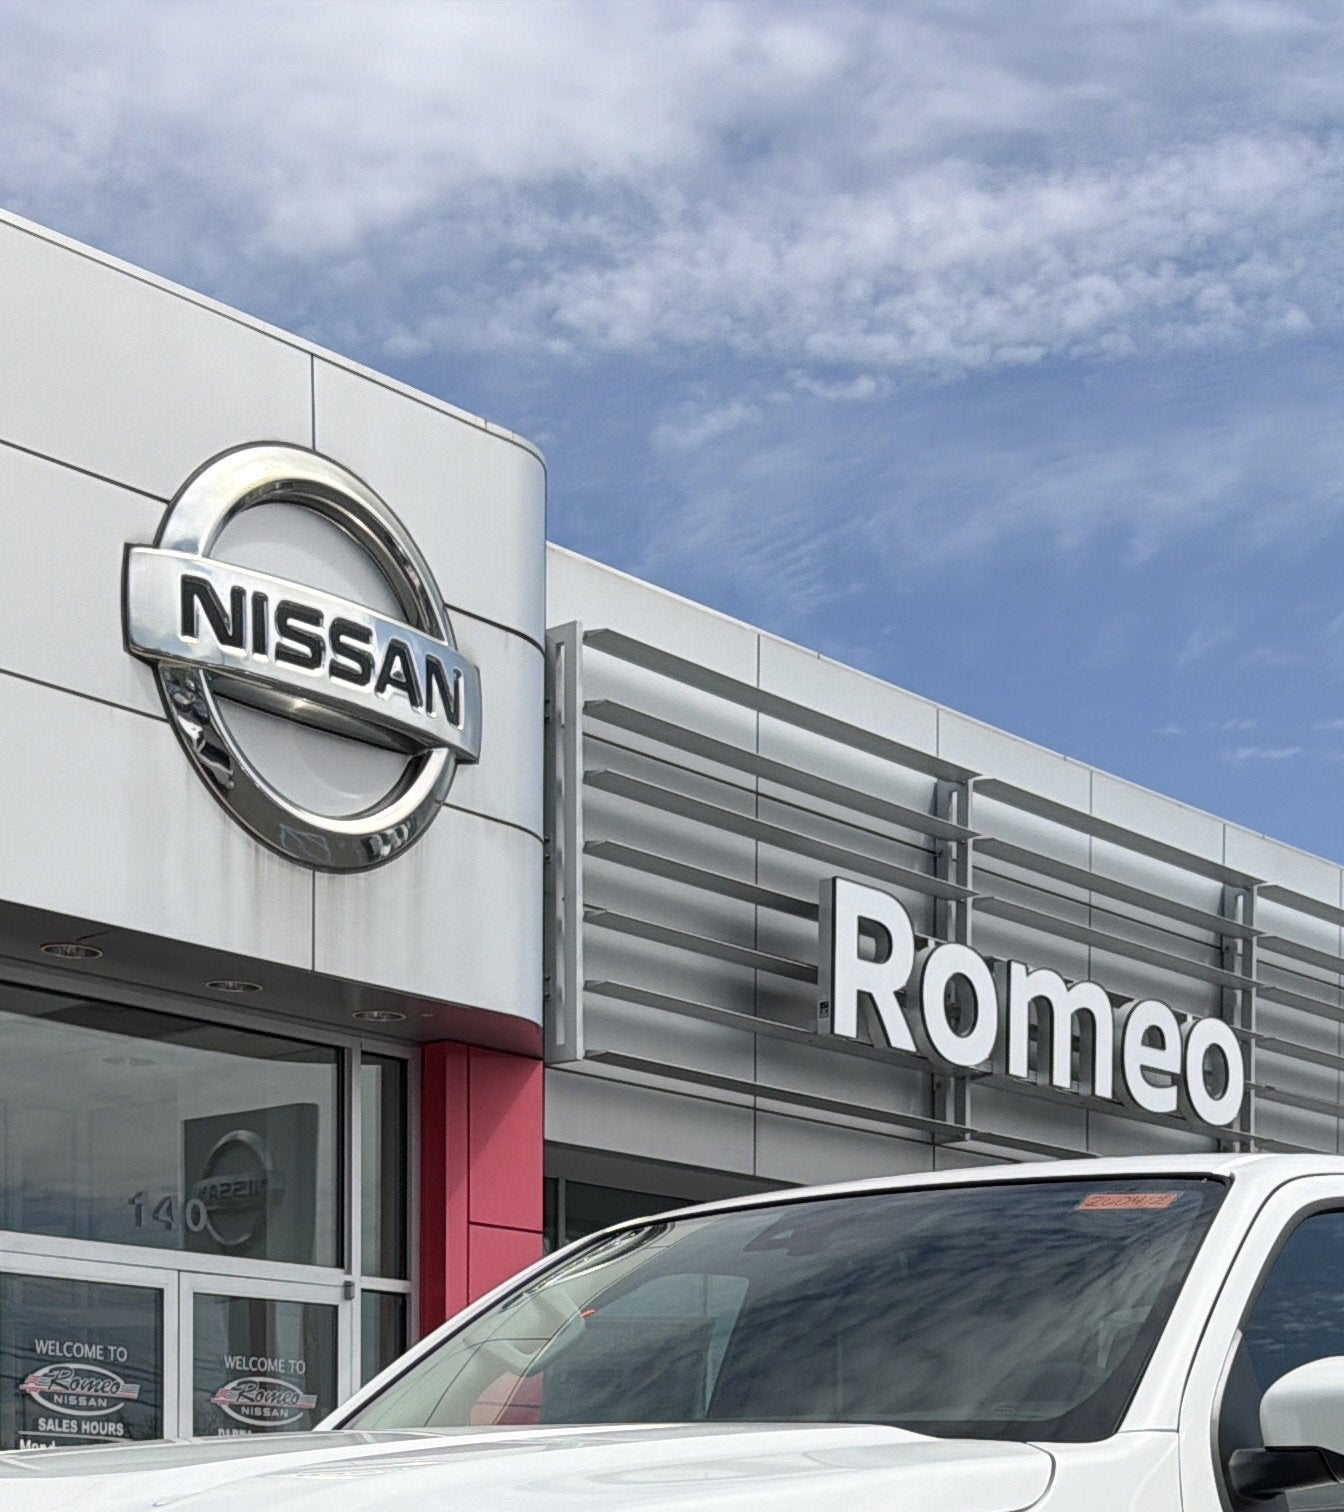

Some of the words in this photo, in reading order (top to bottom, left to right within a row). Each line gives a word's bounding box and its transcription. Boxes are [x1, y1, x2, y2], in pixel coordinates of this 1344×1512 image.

[179, 573, 465, 731] NISSAN
[828, 875, 1245, 1127] Romeo
[128, 1191, 207, 1232] 140
[34, 1338, 104, 1360] WELCOME
[108, 1345, 128, 1362] TO
[224, 1355, 286, 1373] WELCOME
[288, 1359, 306, 1375] TO
[44, 1366, 121, 1395] Romeo
[234, 1380, 301, 1406] Romeo
[53, 1394, 108, 1407] NISSAN
[241, 1406, 289, 1418] NISSAN
[38, 1417, 78, 1433] SALES
[81, 1421, 124, 1436] HOURS
